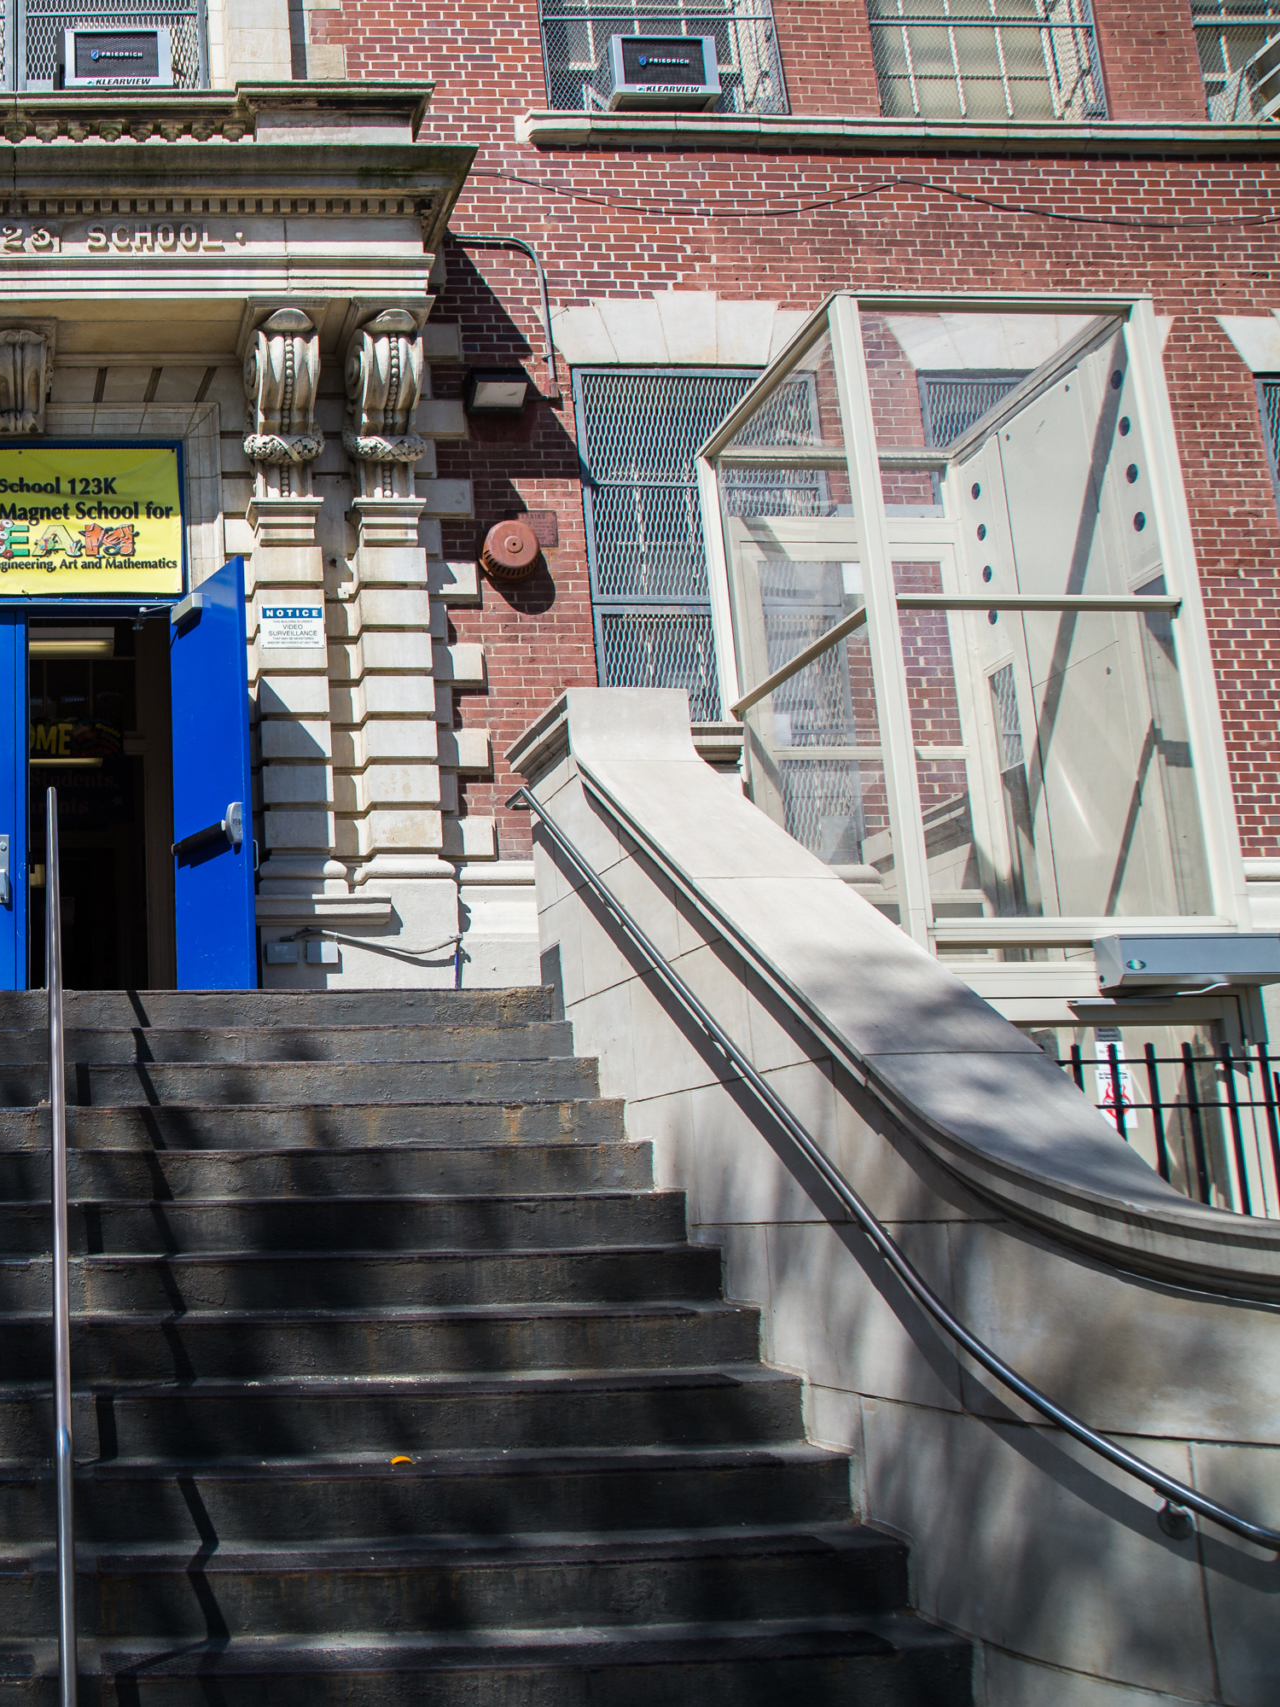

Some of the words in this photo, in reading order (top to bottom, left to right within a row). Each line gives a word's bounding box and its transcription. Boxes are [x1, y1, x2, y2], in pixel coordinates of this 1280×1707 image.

[101, 51, 143, 59] FRIEDRICH
[648, 57, 690, 65] FRIEDRICH
[646, 85, 700, 93] KLEARVIEW
[86, 222, 223, 252] SCHOOL
[67, 477, 117, 495] 123K
[75, 501, 139, 519] School
[145, 501, 173, 519] for
[60, 558, 78, 570] Art
[81, 558, 102, 569] and
[105, 558, 177, 569] Mathematics
[266, 609, 319, 617] NOTICE
